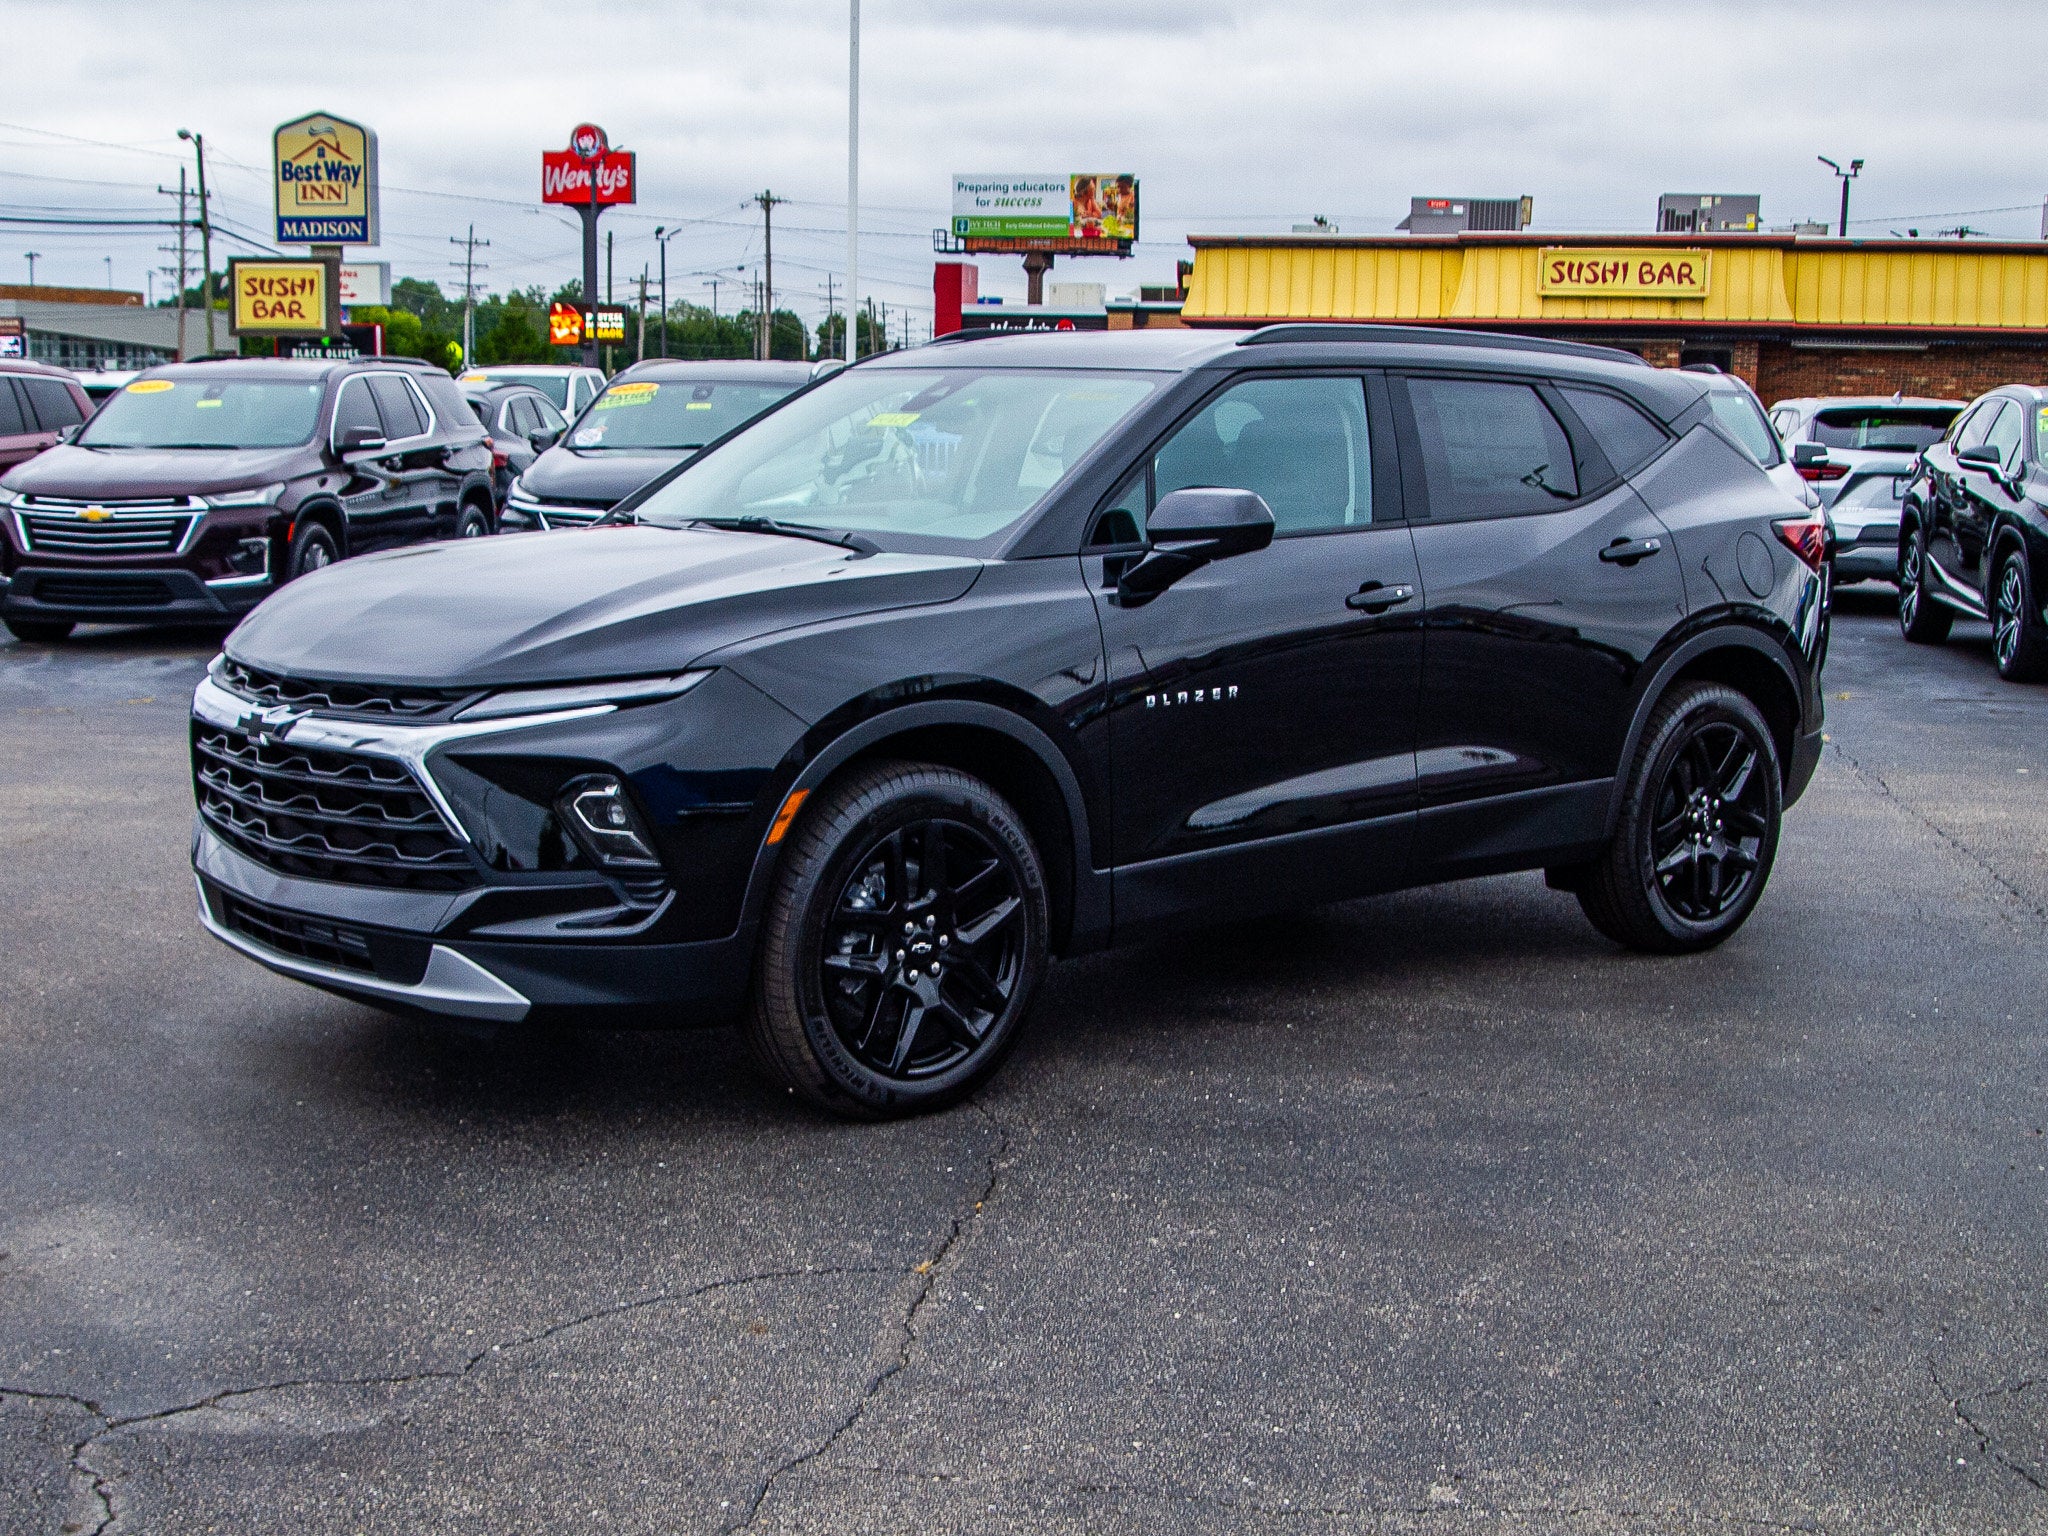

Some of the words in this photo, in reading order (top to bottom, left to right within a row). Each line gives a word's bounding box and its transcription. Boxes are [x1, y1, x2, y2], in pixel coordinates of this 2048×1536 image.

[281, 160, 322, 182] Best
[323, 160, 362, 189] Way
[301, 183, 343, 201] INN
[957, 181, 1009, 195] Preparing
[1012, 181, 1066, 193] educators
[975, 196, 990, 207] for
[994, 196, 1043, 207] success
[282, 221, 363, 238] MADISON
[1550, 260, 1629, 285] SUSHI
[1638, 261, 1696, 285] BAR
[244, 276, 315, 297] SUSHI
[252, 300, 306, 319] BAR
[291, 347, 322, 359] BLACK
[325, 347, 360, 359] OLIVES
